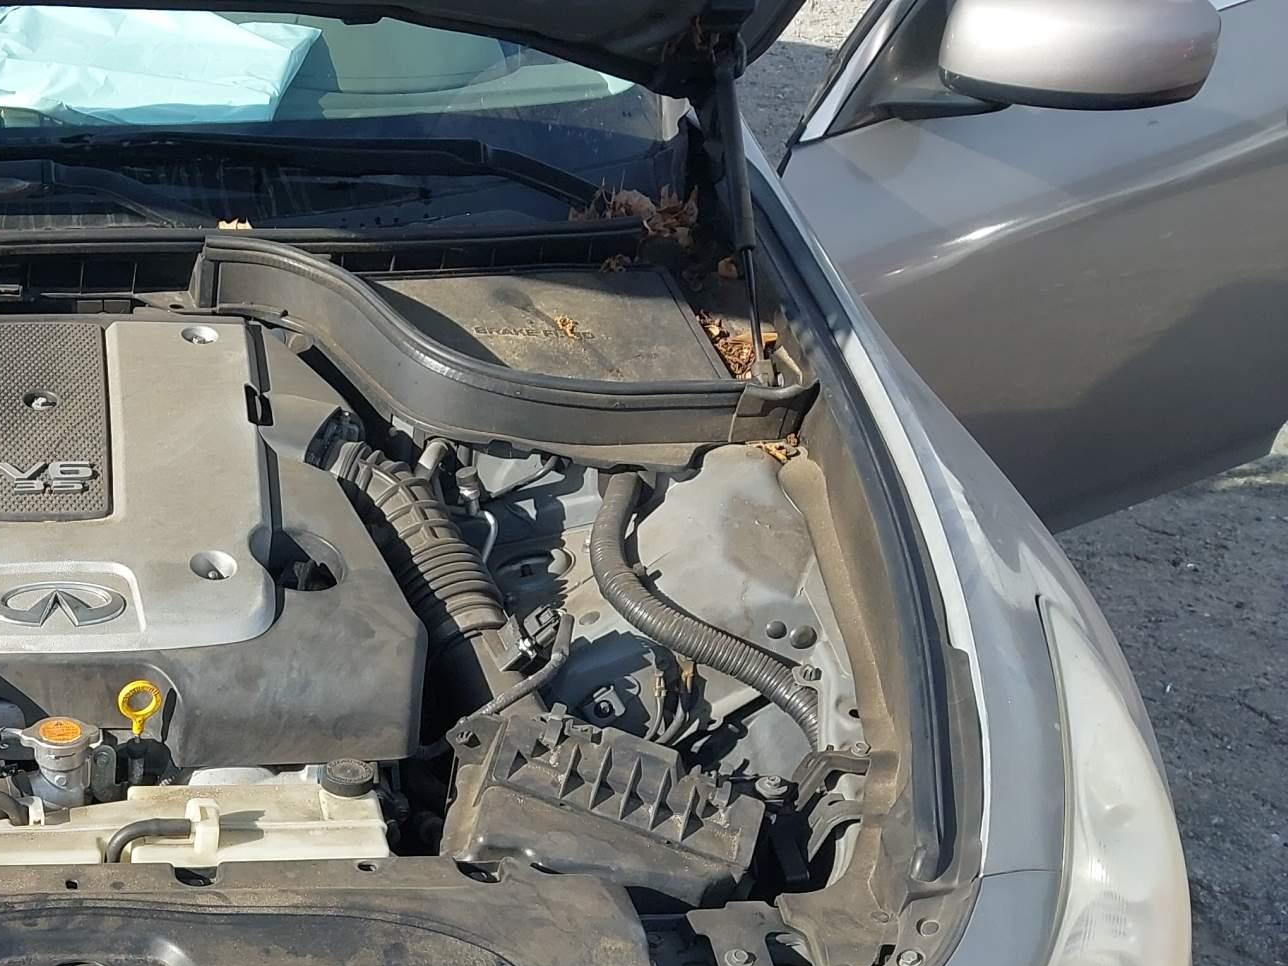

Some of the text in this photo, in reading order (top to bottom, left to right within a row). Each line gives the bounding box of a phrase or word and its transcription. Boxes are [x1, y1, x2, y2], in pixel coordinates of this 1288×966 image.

[473, 327, 595, 340] BRAKE FLID
[13, 480, 84, 495] 3.5
